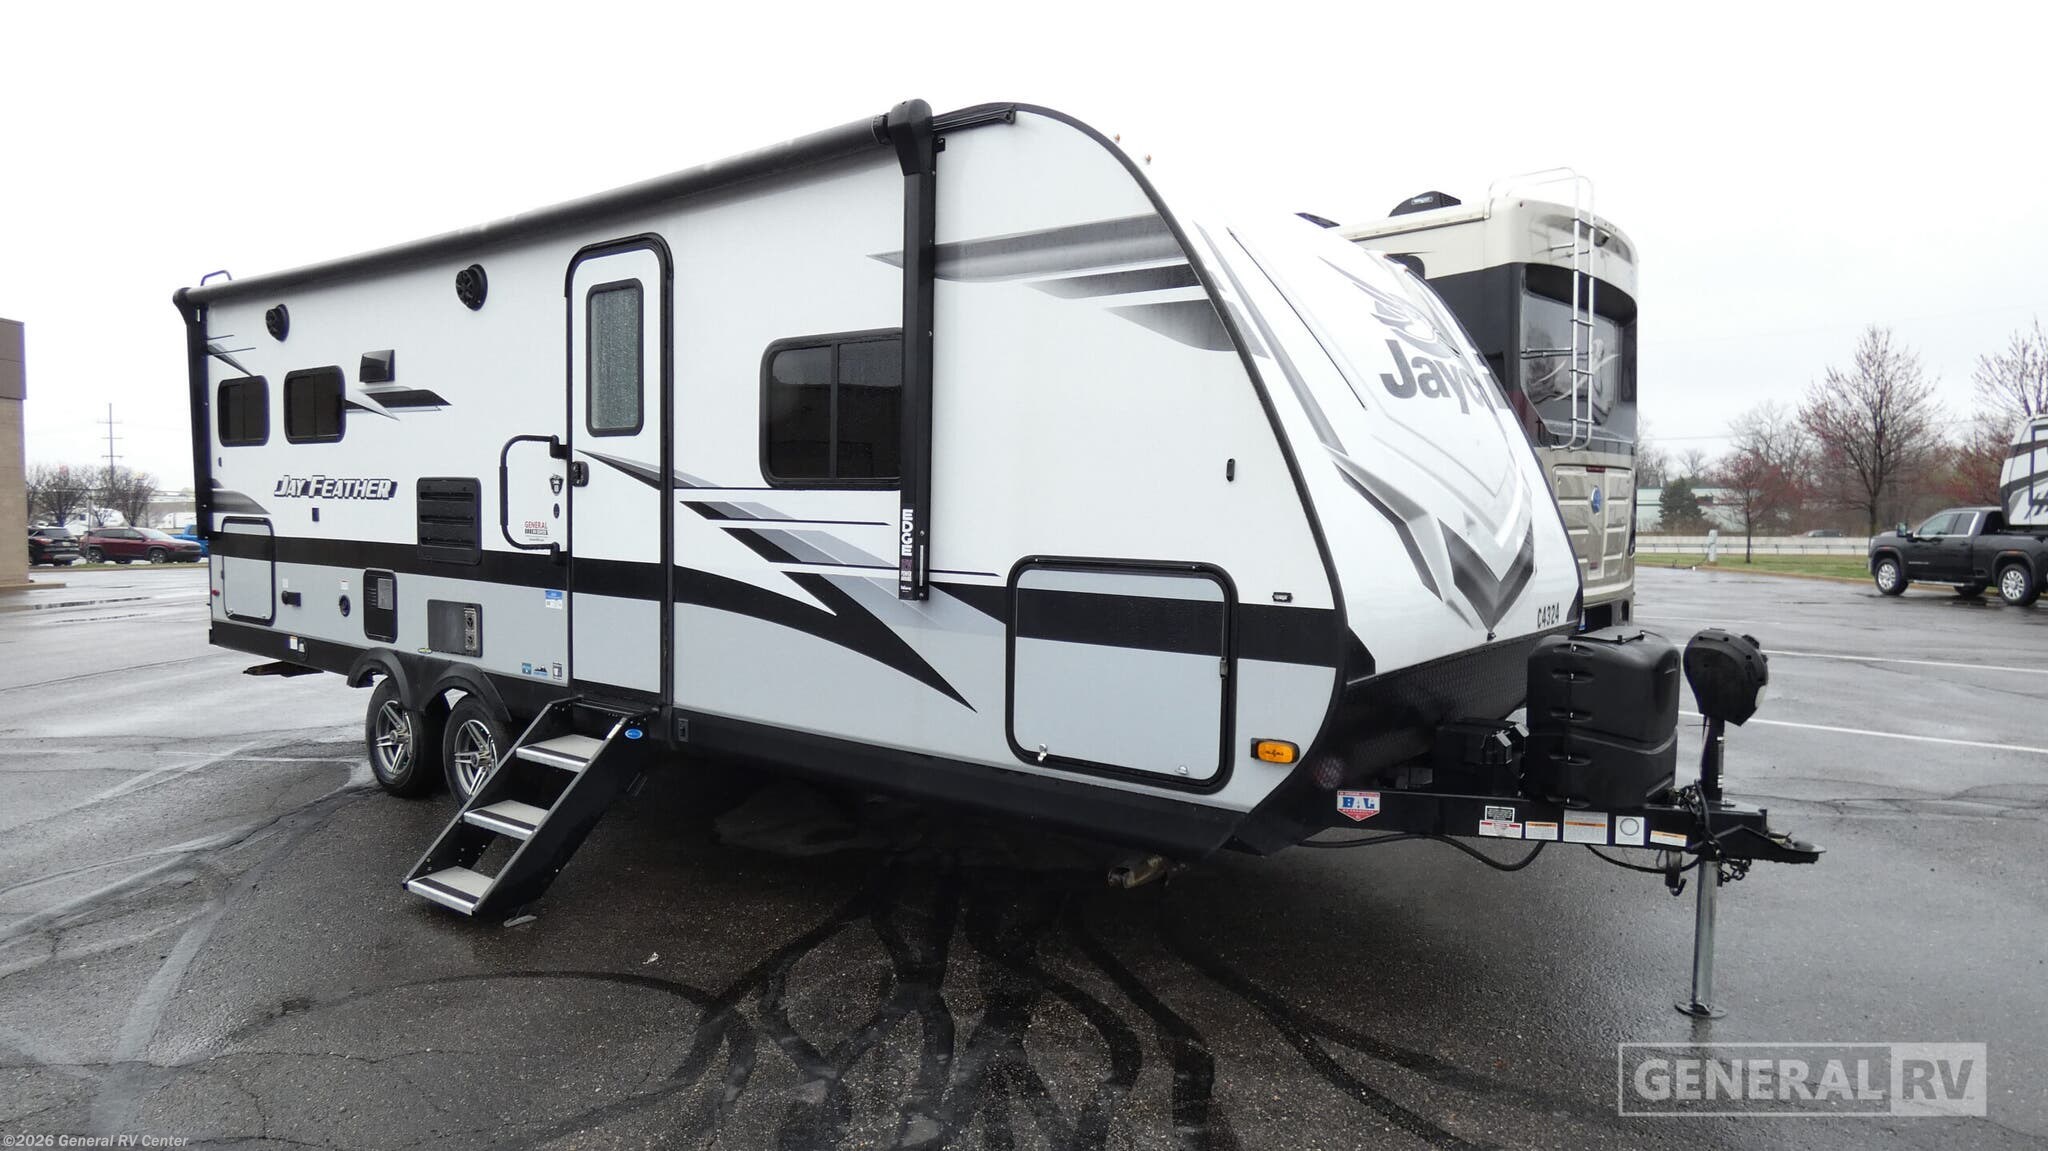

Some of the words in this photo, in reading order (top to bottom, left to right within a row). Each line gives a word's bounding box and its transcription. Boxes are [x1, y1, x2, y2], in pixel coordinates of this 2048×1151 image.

[274, 475, 307, 498] JAY
[308, 475, 396, 500] FEATHER
[524, 521, 548, 529] GENERAL
[901, 508, 914, 556] EDGE
[1537, 602, 1560, 629] C4324
